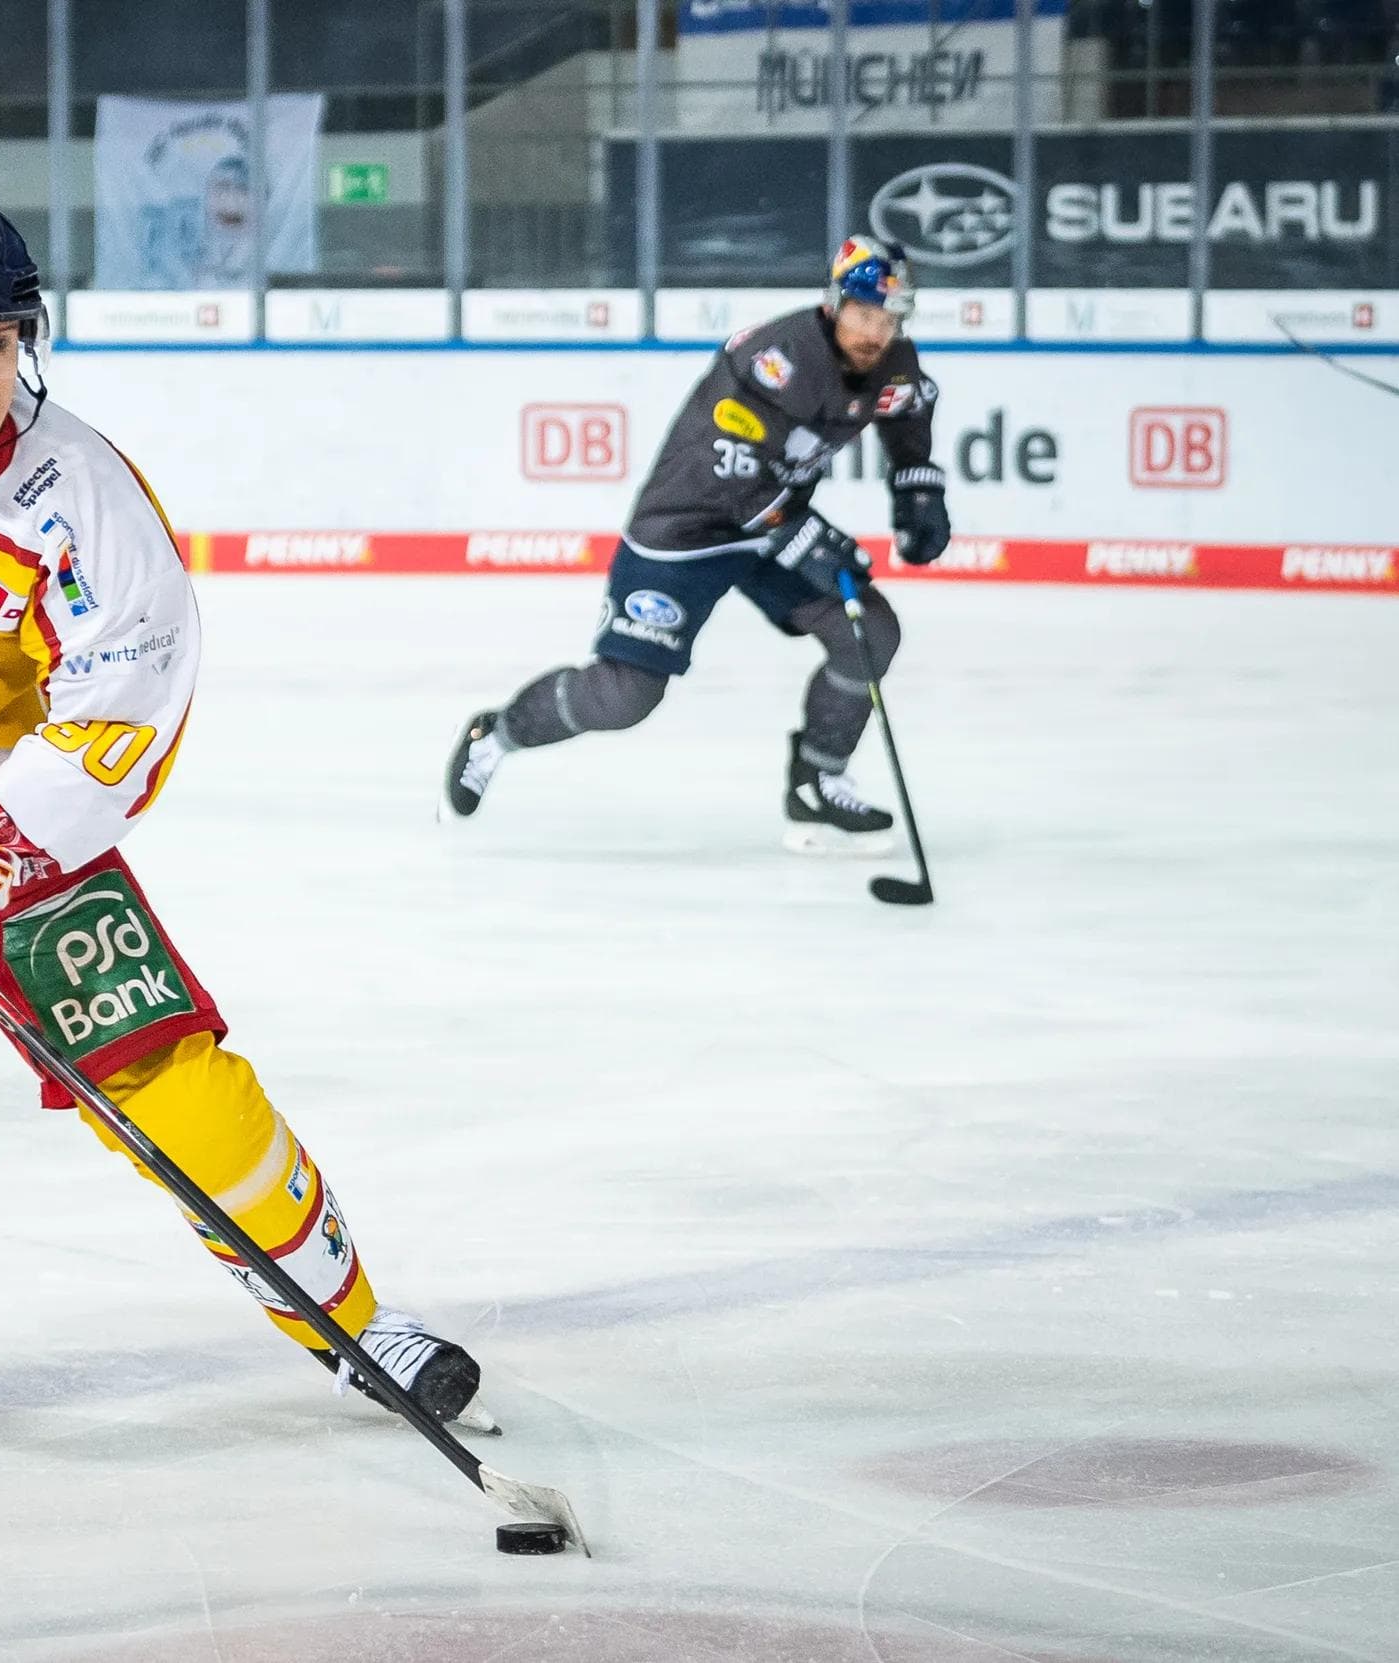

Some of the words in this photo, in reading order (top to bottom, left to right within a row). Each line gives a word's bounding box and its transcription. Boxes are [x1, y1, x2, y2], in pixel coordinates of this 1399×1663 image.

[1047, 182, 1378, 242] SUBARU
[535, 416, 614, 469] DB
[713, 438, 760, 480] 36
[1142, 421, 1215, 473] DB
[13, 457, 58, 504] Effecten
[20, 467, 62, 510] Spiegel
[100, 645, 137, 663] wirtz
[41, 720, 158, 787] 90
[55, 907, 150, 987] psd
[50, 964, 182, 1046] Bank
